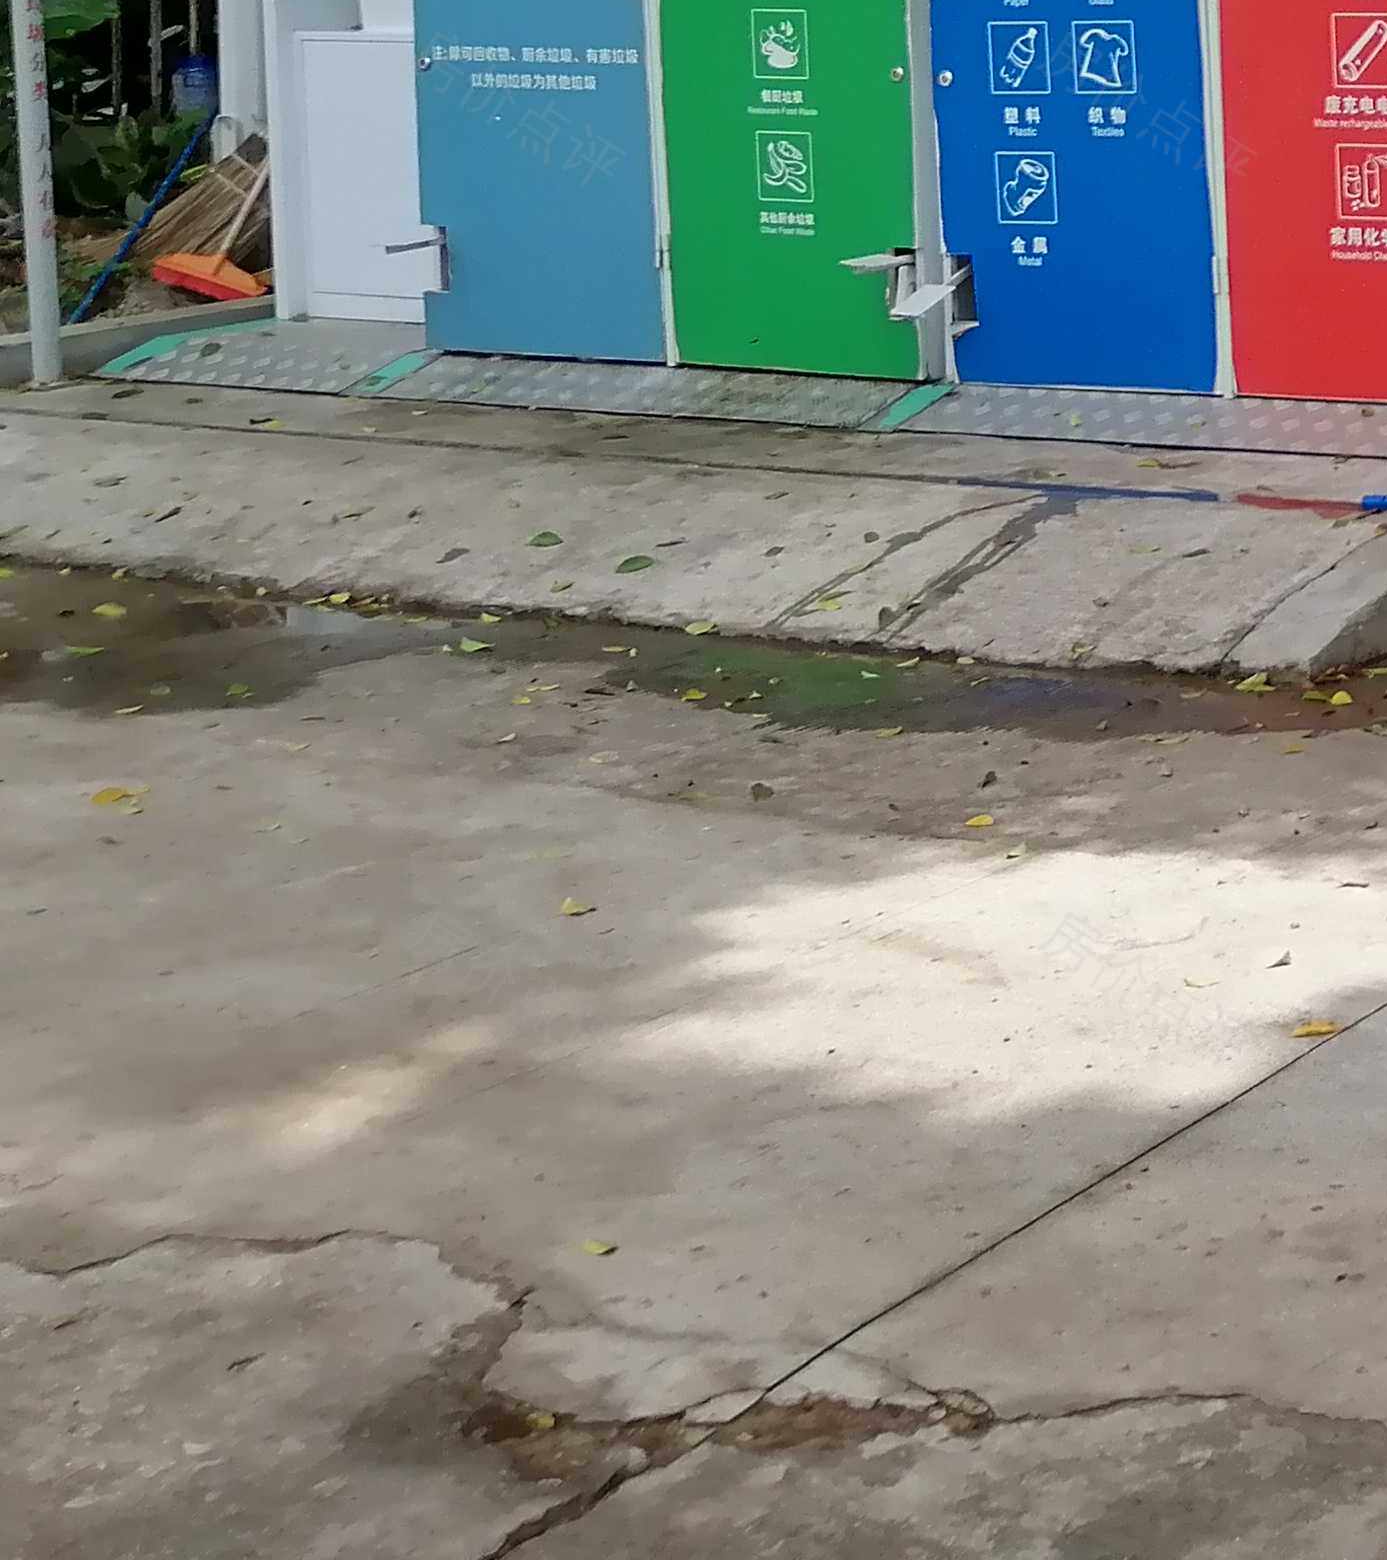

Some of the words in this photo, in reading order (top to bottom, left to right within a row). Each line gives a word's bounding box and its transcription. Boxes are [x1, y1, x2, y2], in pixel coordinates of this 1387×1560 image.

[1004, 106, 1041, 124] 塑料
[1087, 106, 1126, 124] 织物
[1008, 126, 1038, 137] Plastic
[1011, 236, 1048, 254] 金属
